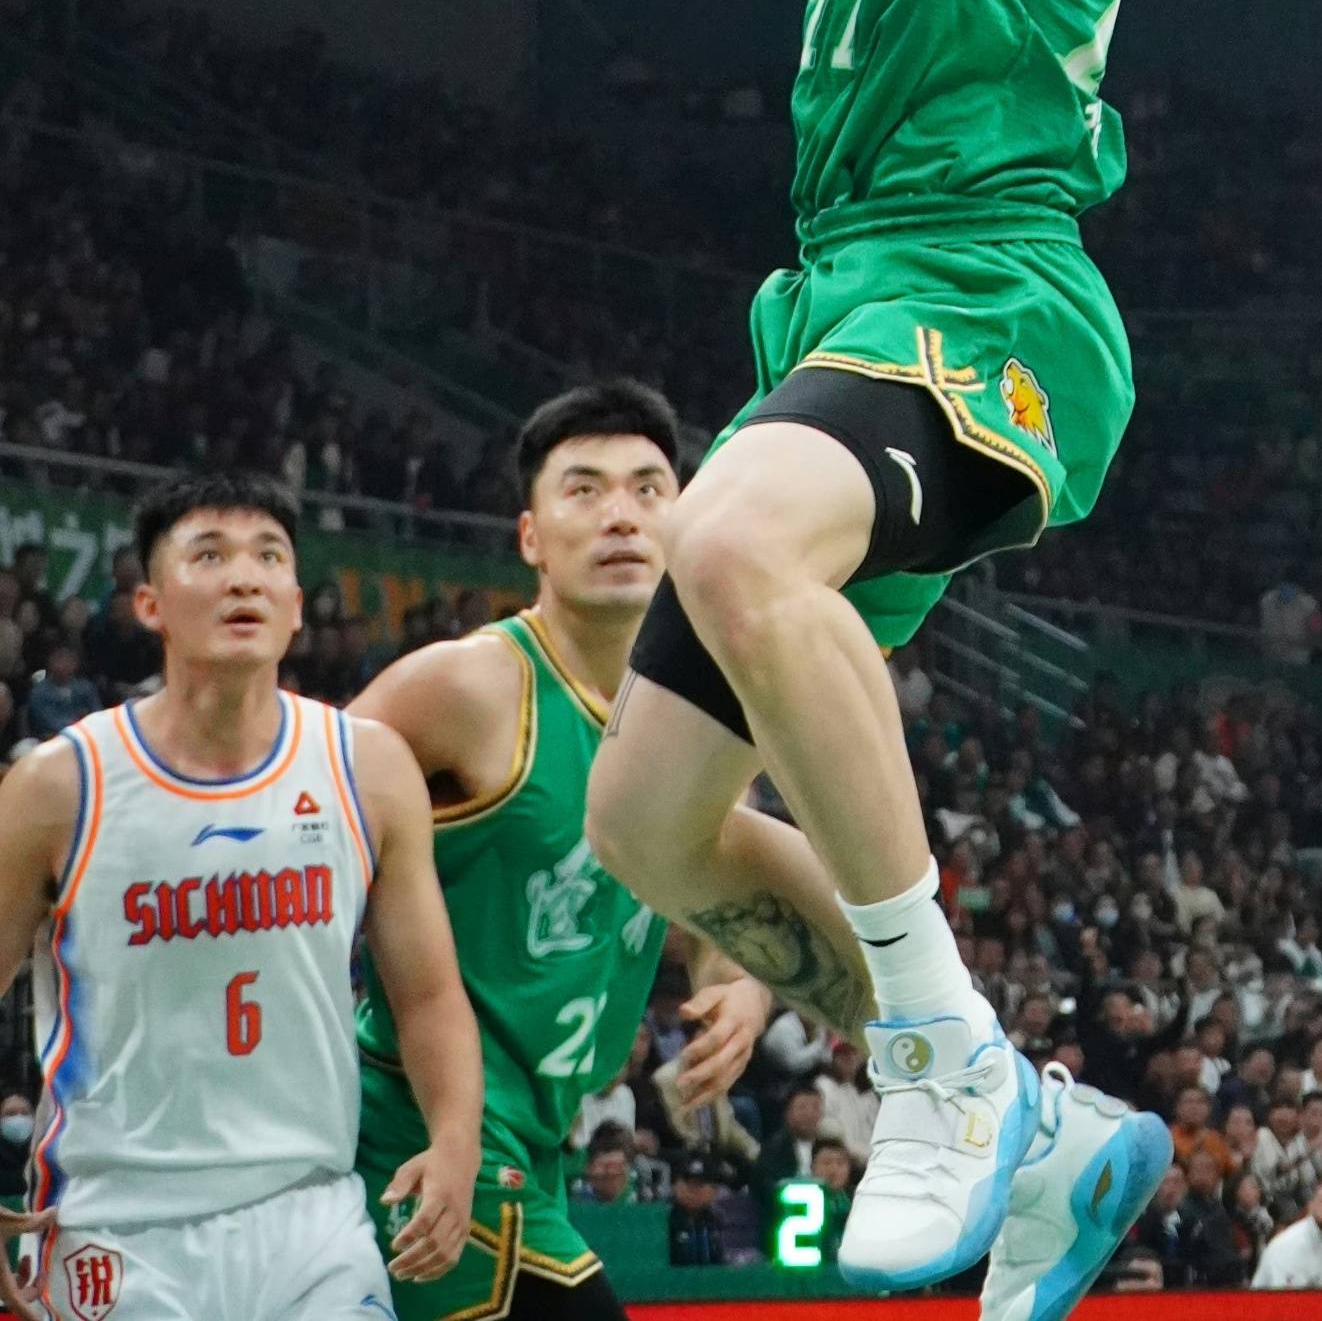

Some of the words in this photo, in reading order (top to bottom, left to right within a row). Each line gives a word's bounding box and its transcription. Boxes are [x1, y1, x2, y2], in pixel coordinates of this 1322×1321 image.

[123, 863, 335, 947] SICHUAN
[225, 970, 262, 1057] 6
[776, 1182, 825, 1266] 2
